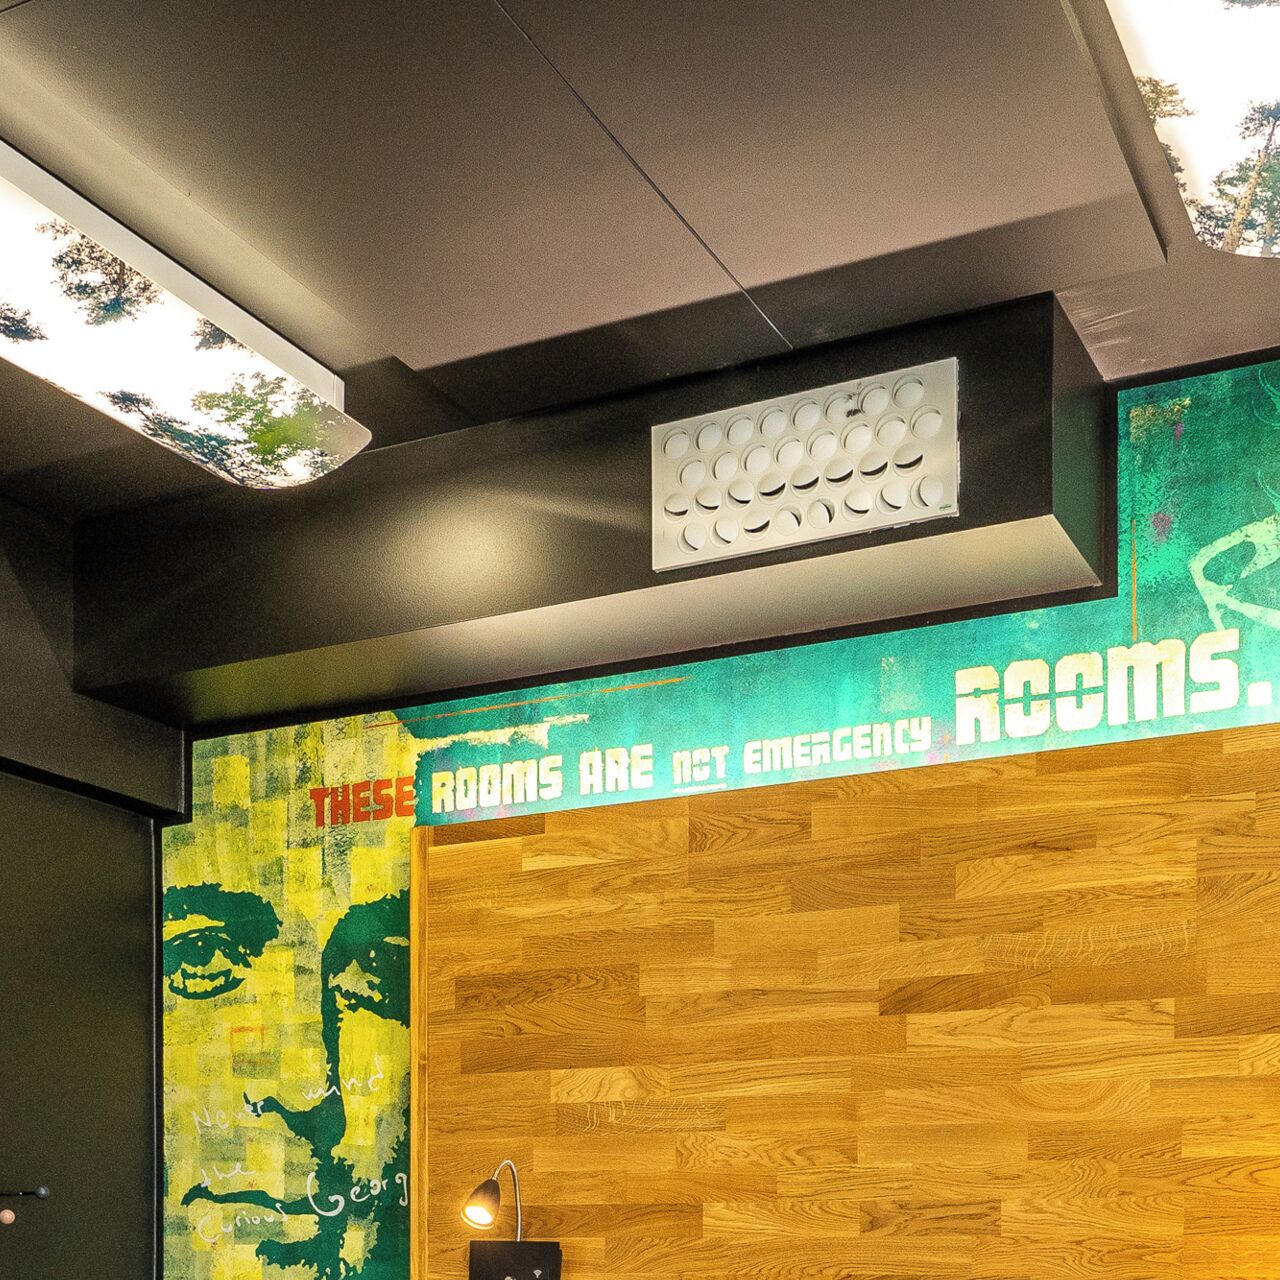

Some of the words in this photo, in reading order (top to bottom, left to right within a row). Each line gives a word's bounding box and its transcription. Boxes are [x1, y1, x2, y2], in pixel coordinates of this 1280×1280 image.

[309, 775, 415, 828] THESE
[431, 755, 564, 815] ROOMS
[578, 743, 654, 796] ARE
[672, 745, 730, 786] NOT
[743, 715, 932, 775] EMERGENCY
[954, 628, 1272, 747] ROOMS.
